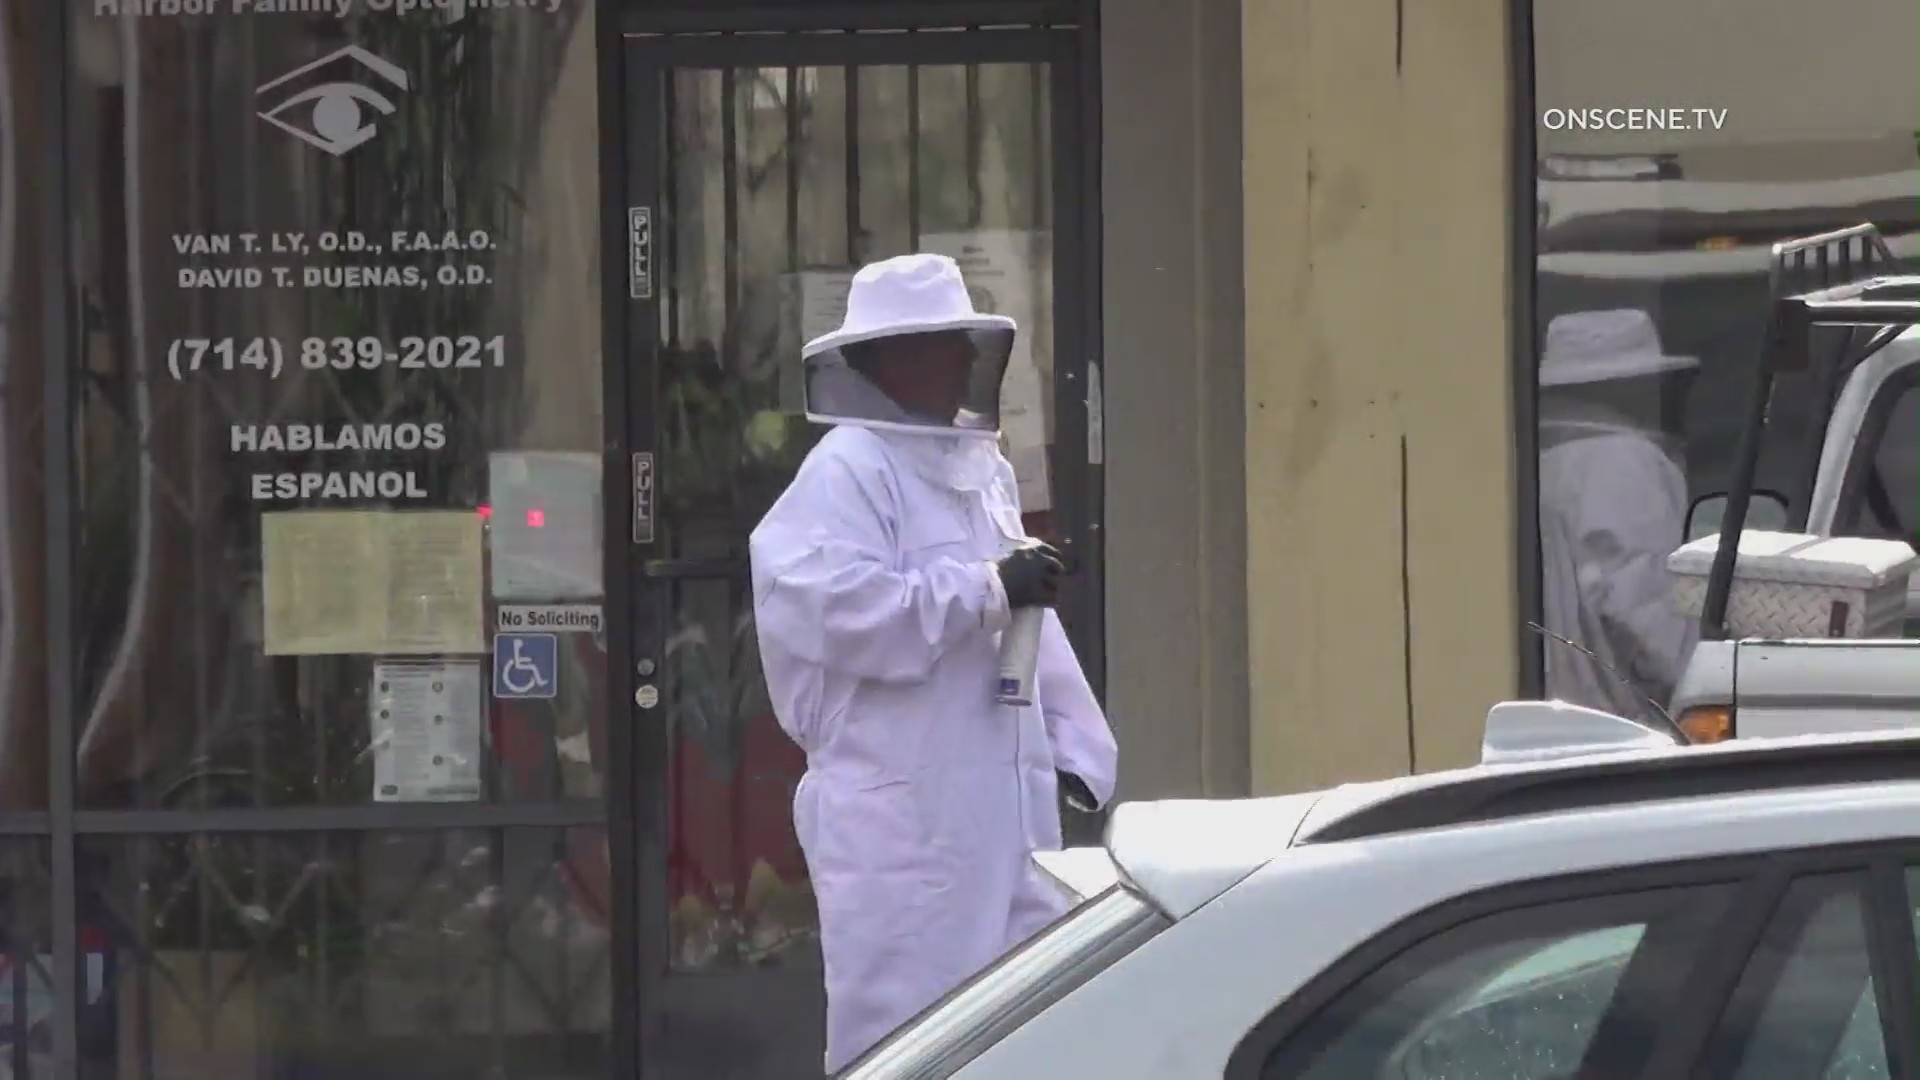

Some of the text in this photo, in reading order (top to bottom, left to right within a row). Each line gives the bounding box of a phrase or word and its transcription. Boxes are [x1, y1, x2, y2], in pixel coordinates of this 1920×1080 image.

[172, 230, 497, 255] VAN T. LY, O.D., F.A.A.O.
[634, 215, 648, 276] PULL
[178, 264, 493, 289] DAVID T. DUENAS, O.D.
[167, 335, 506, 380] (714) 839-2021
[230, 423, 447, 451] HABLAMOS
[251, 471, 428, 499] ESPANOL
[637, 461, 651, 521] PULL
[501, 611, 600, 630] No Soliciting
